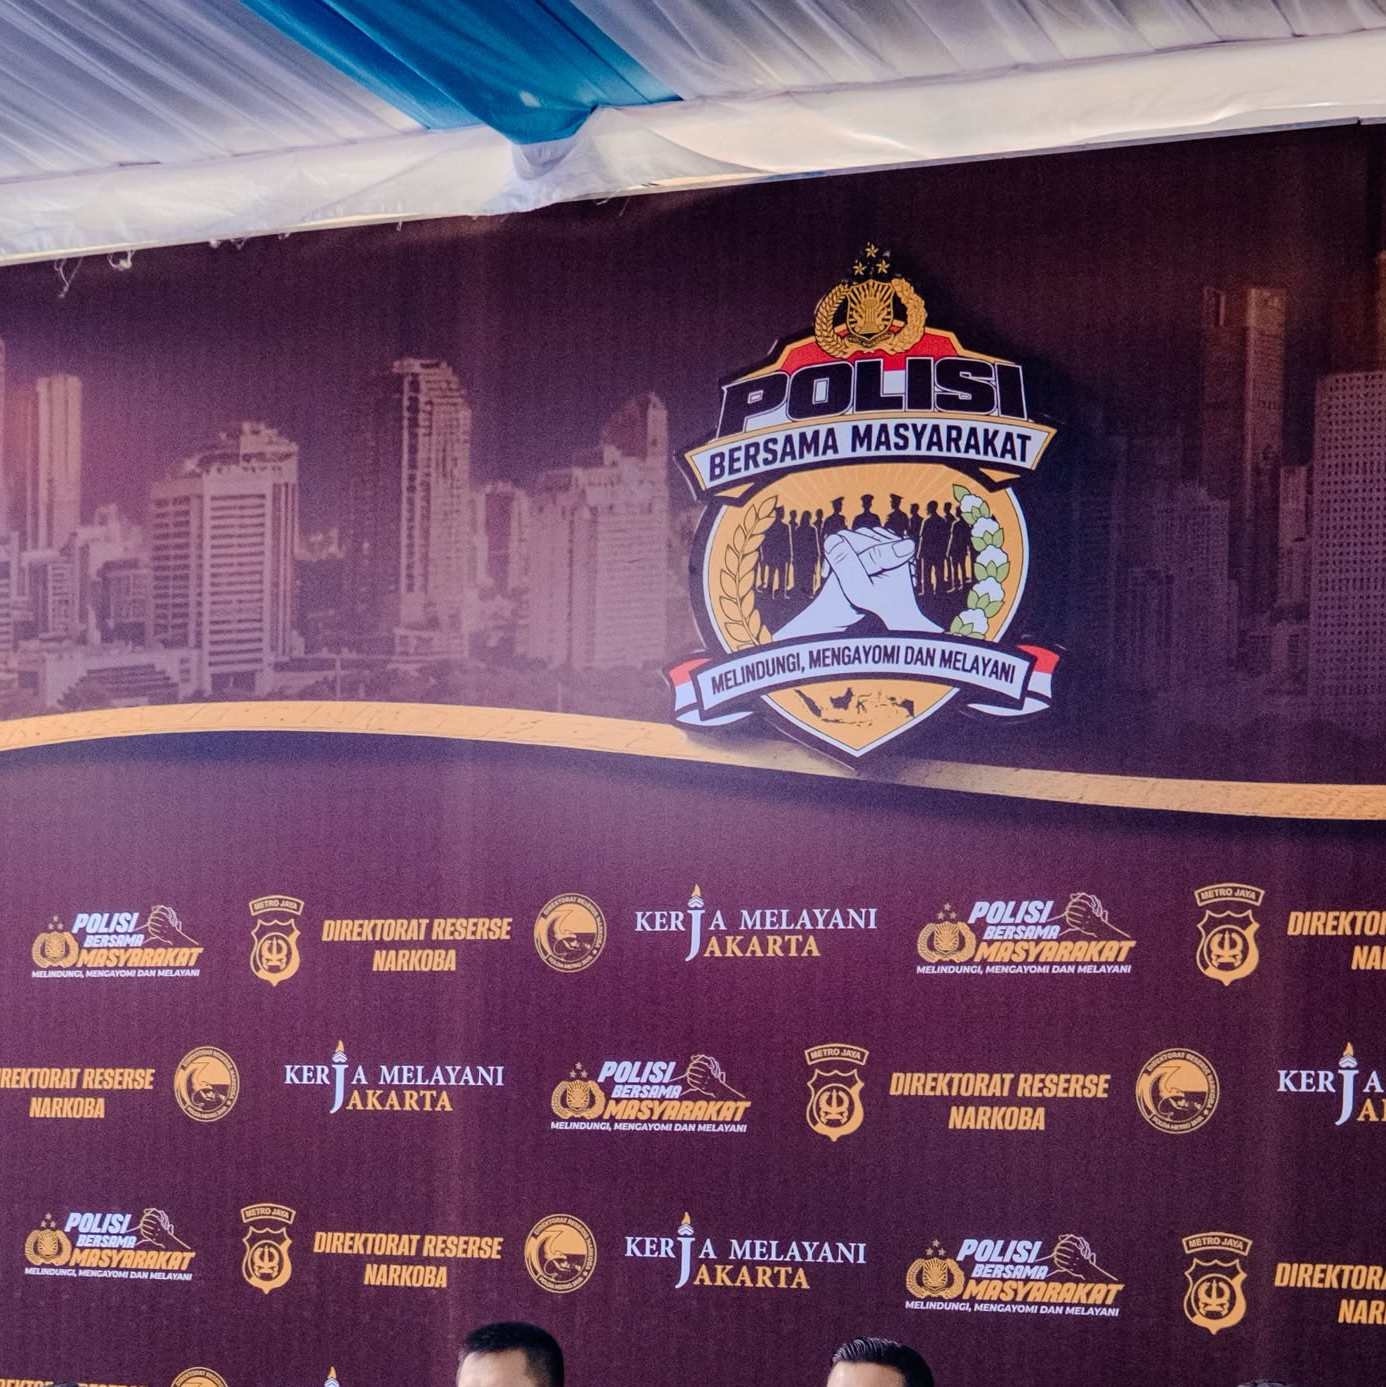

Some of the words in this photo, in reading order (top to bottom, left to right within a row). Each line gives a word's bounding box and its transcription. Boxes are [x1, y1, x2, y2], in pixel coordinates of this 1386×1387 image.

[719, 357, 1029, 441] POLISI
[709, 425, 839, 482] BERSAMA
[851, 421, 1034, 462] MASYARAKAT
[711, 652, 805, 695] MELINDUNGI,
[809, 645, 900, 669] MENGAYOMI
[904, 646, 936, 667] DAN
[939, 649, 1016, 684] MELAYANI
[1200, 887, 1231, 901] METRO
[1234, 888, 1258, 901] JAYA
[72, 913, 139, 934] POLISI
[739, 908, 877, 930] MELAYANI
[968, 901, 1054, 925] POLISI
[322, 919, 429, 941] DIREKTORAT
[431, 918, 513, 940] RESERSE
[982, 925, 1059, 940] BERSAMA
[84, 934, 143, 947] BERSAMA
[973, 939, 1136, 962] MASYARAKAT
[77, 947, 203, 967] MASYARAKAT
[373, 950, 456, 971] NARKOBA
[810, 1048, 839, 1060] METRO
[841, 1048, 862, 1060] JAYA
[82, 1068, 155, 1089] RESERSE
[378, 1065, 504, 1086] MELAYANI
[598, 1061, 676, 1083] POLISI
[611, 1084, 681, 1098] BERSAMA
[890, 1072, 1014, 1096] DIREKTORAT
[1017, 1074, 1111, 1098] RESERSE
[30, 1097, 104, 1118] NARKOBA
[602, 1099, 751, 1120] MASYARAKAT
[948, 1106, 1045, 1130] NARKOBA
[729, 1239, 866, 1264] MELAYANI
